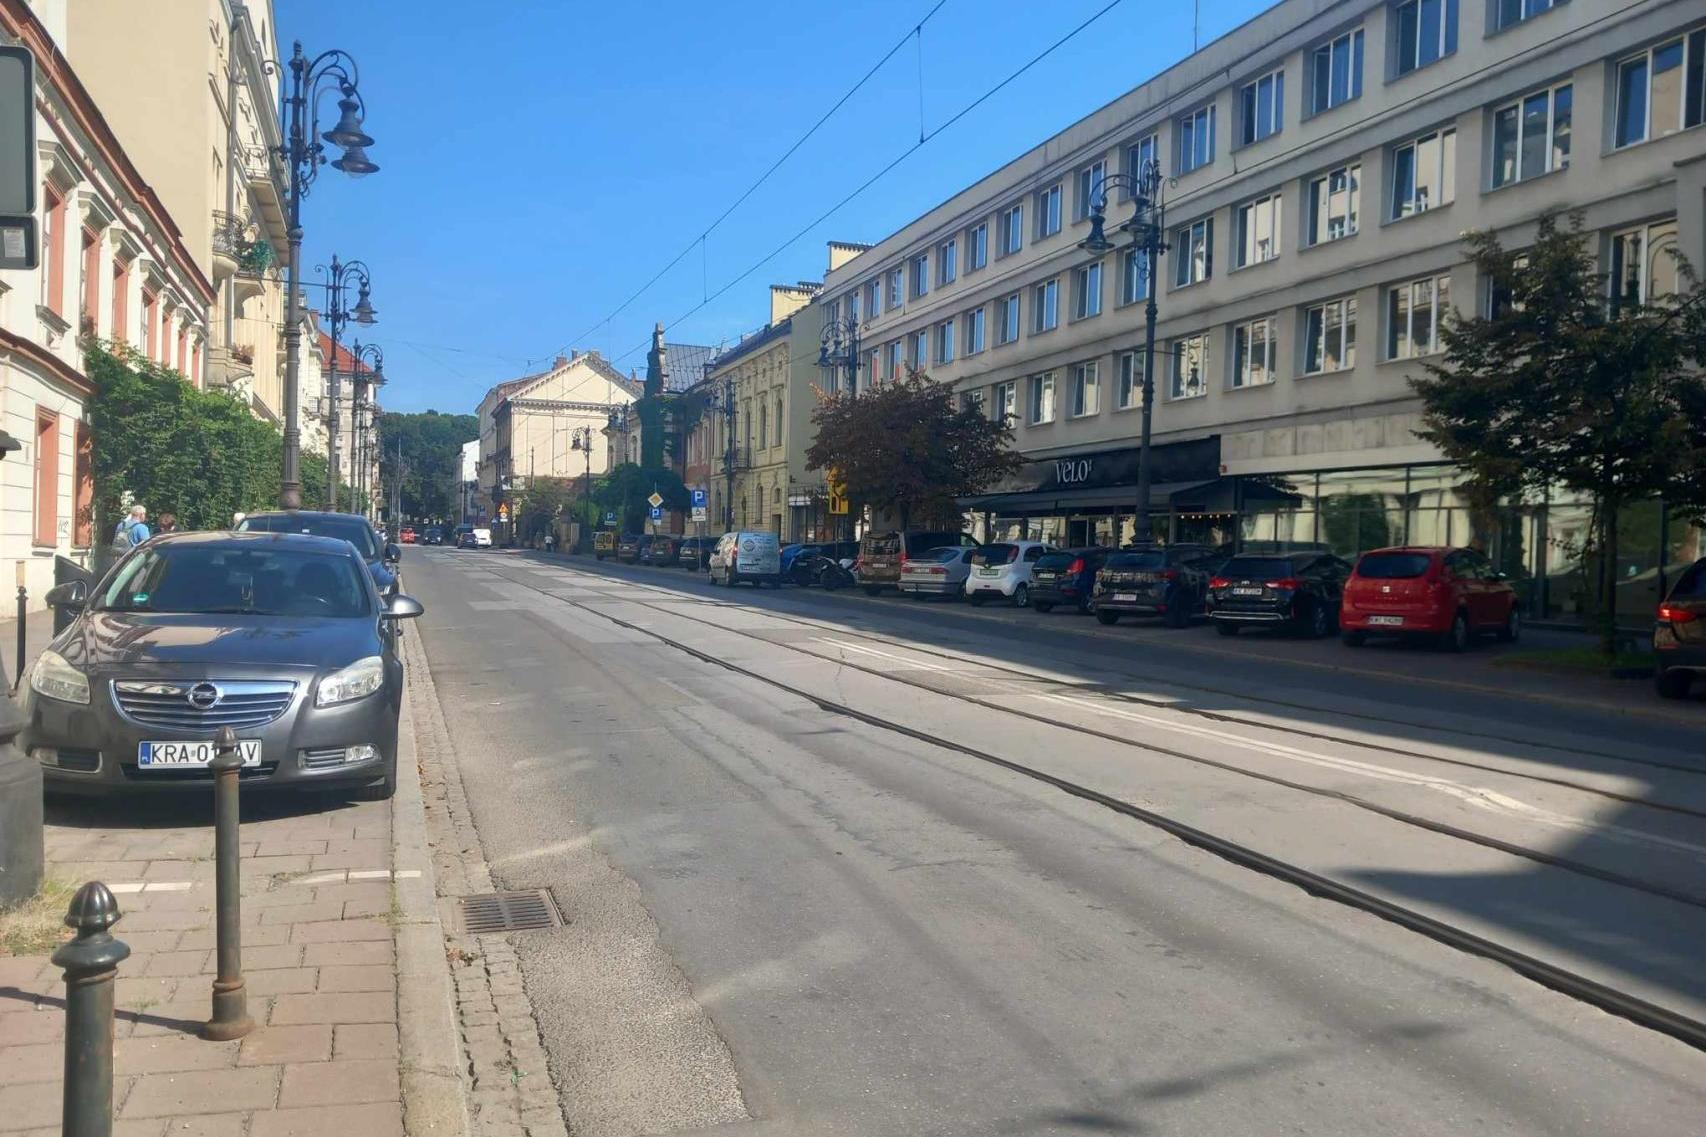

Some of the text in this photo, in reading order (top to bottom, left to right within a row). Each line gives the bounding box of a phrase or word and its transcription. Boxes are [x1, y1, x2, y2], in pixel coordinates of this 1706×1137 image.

[694, 491, 703, 502] P
[652, 509, 660, 518] P
[152, 744, 190, 763] KRA
